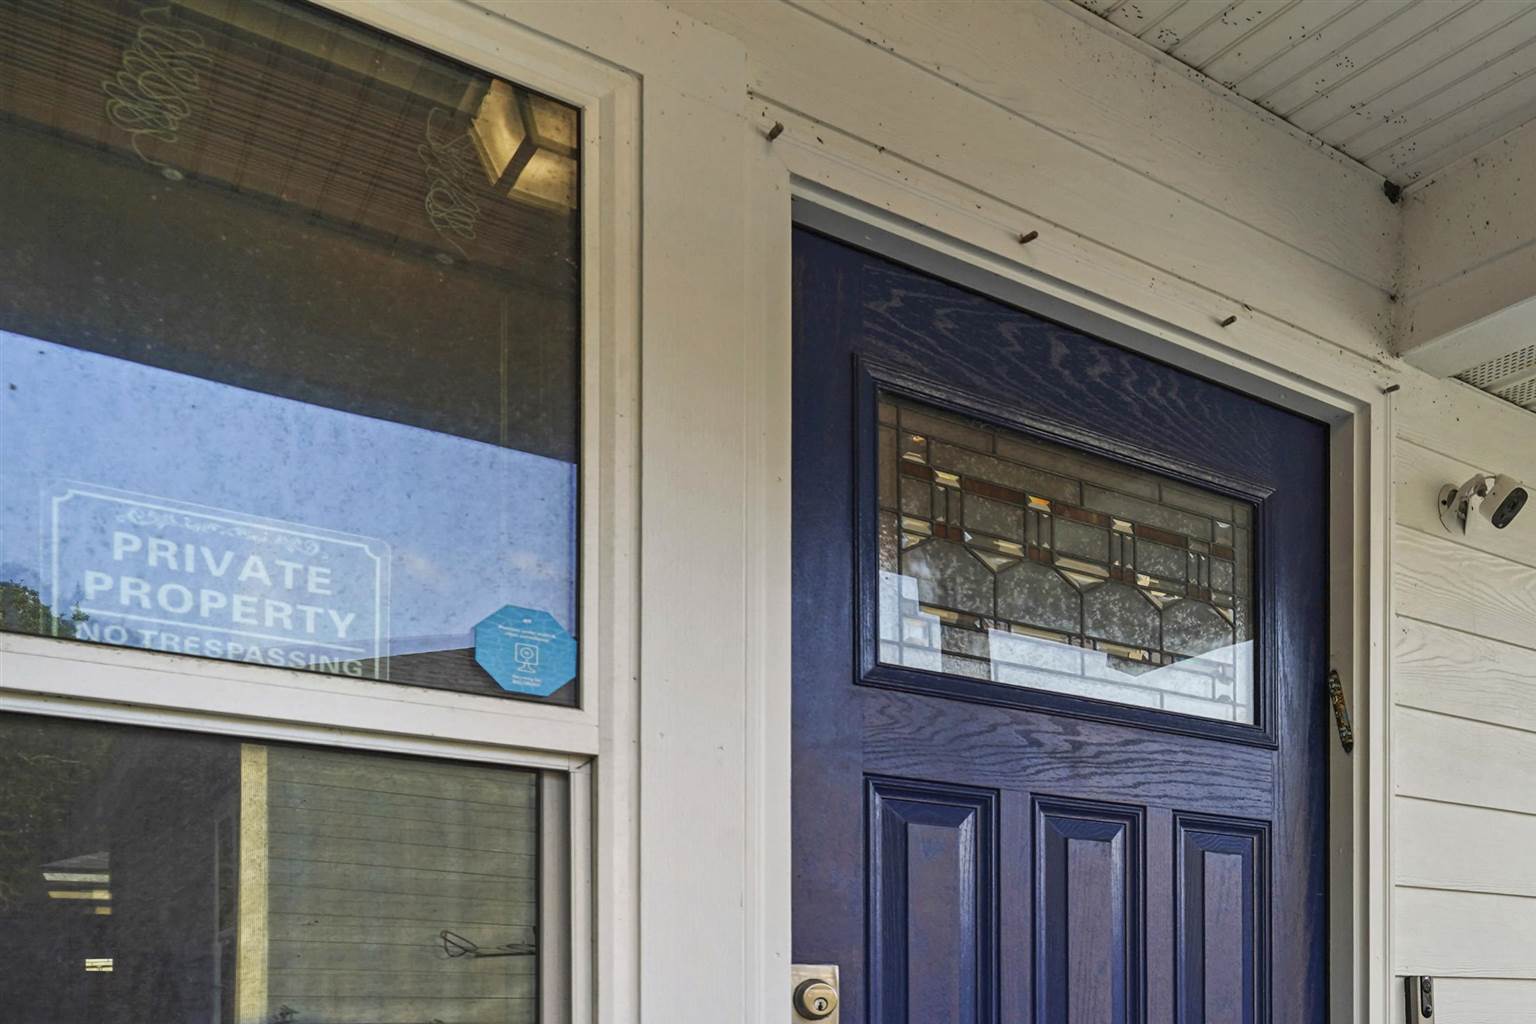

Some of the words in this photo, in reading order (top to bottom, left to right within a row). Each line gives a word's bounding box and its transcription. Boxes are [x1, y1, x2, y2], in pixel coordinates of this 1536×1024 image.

[112, 531, 333, 595] PRIVATE
[83, 570, 356, 638] PROPERTY
[75, 622, 128, 644] NO
[138, 629, 363, 677] TRESPASSING
